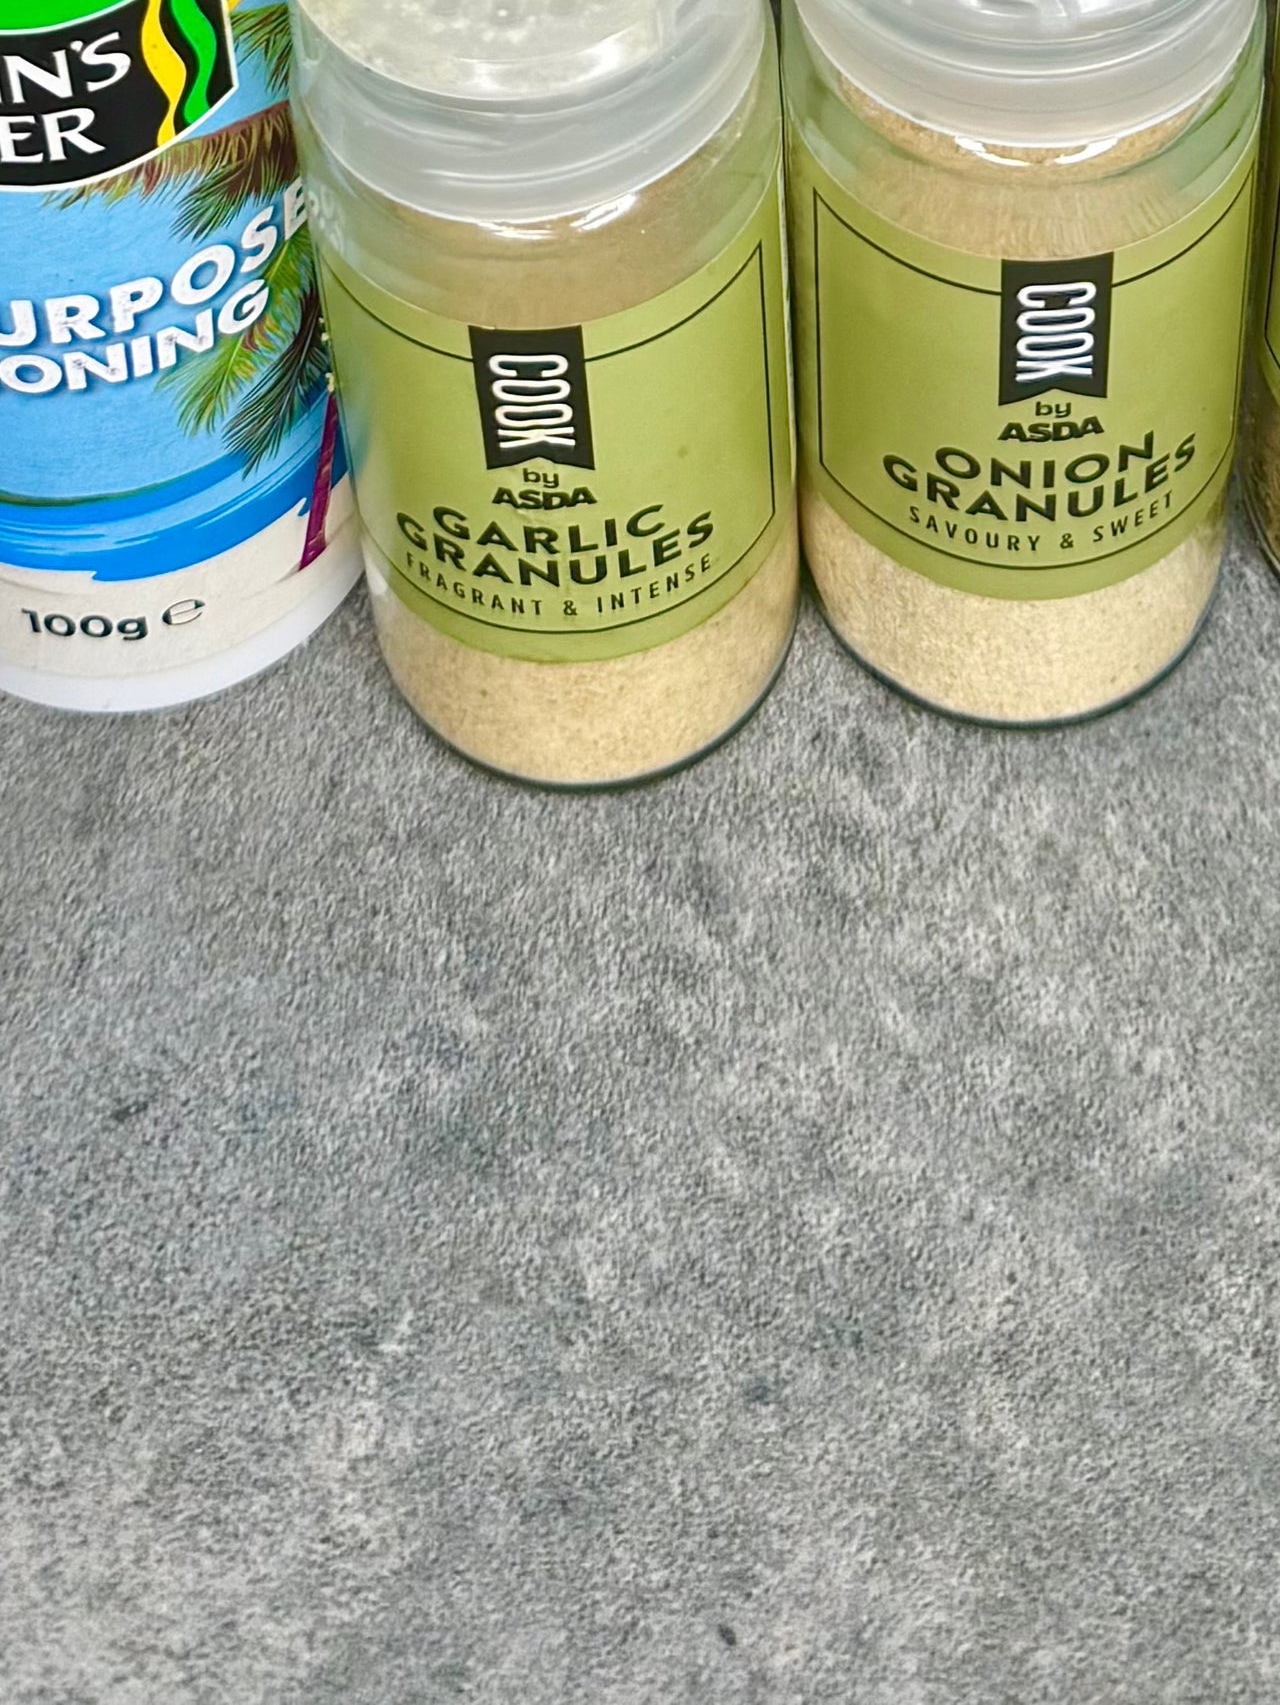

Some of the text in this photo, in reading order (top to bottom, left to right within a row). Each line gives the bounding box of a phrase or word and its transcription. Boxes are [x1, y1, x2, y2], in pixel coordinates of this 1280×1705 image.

[1015, 281, 1097, 383] COOK
[487, 353, 577, 450] COOK
[997, 415, 1105, 444] ASDA
[1034, 400, 1073, 420] by
[523, 467, 560, 489] by
[881, 432, 1197, 524] GRANULES
[934, 429, 1155, 490] ONION
[491, 486, 598, 511] ASDA
[908, 489, 1174, 553] SAVOURY & SWEET
[396, 510, 715, 589] GRANULES
[432, 503, 666, 556] GARLIC
[405, 552, 714, 618] FRAGRANT & INTENSE
[21, 607, 149, 641] 100g
